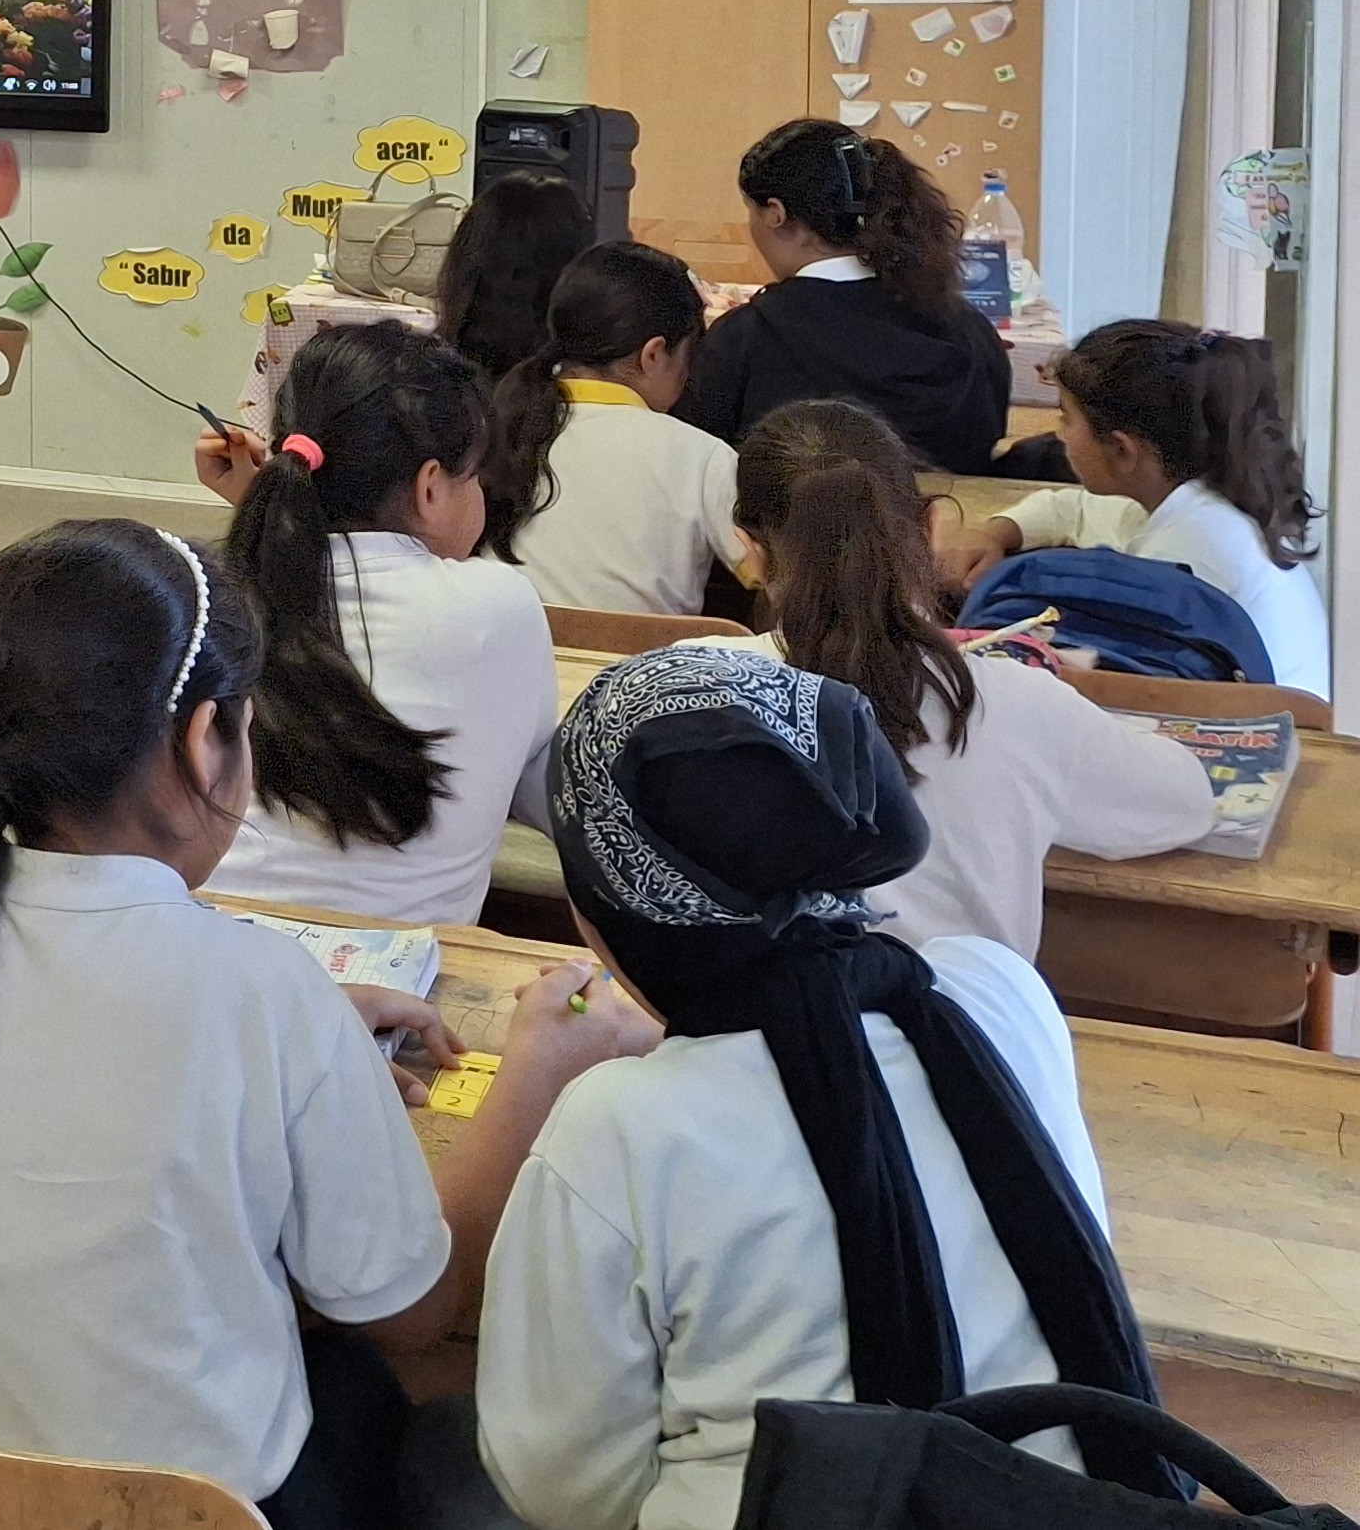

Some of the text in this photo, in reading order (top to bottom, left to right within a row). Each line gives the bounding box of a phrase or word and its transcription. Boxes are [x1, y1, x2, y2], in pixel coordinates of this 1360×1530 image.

[376, 140, 434, 162] acar.
[223, 223, 252, 246] da
[446, 1096, 461, 1107] 2
